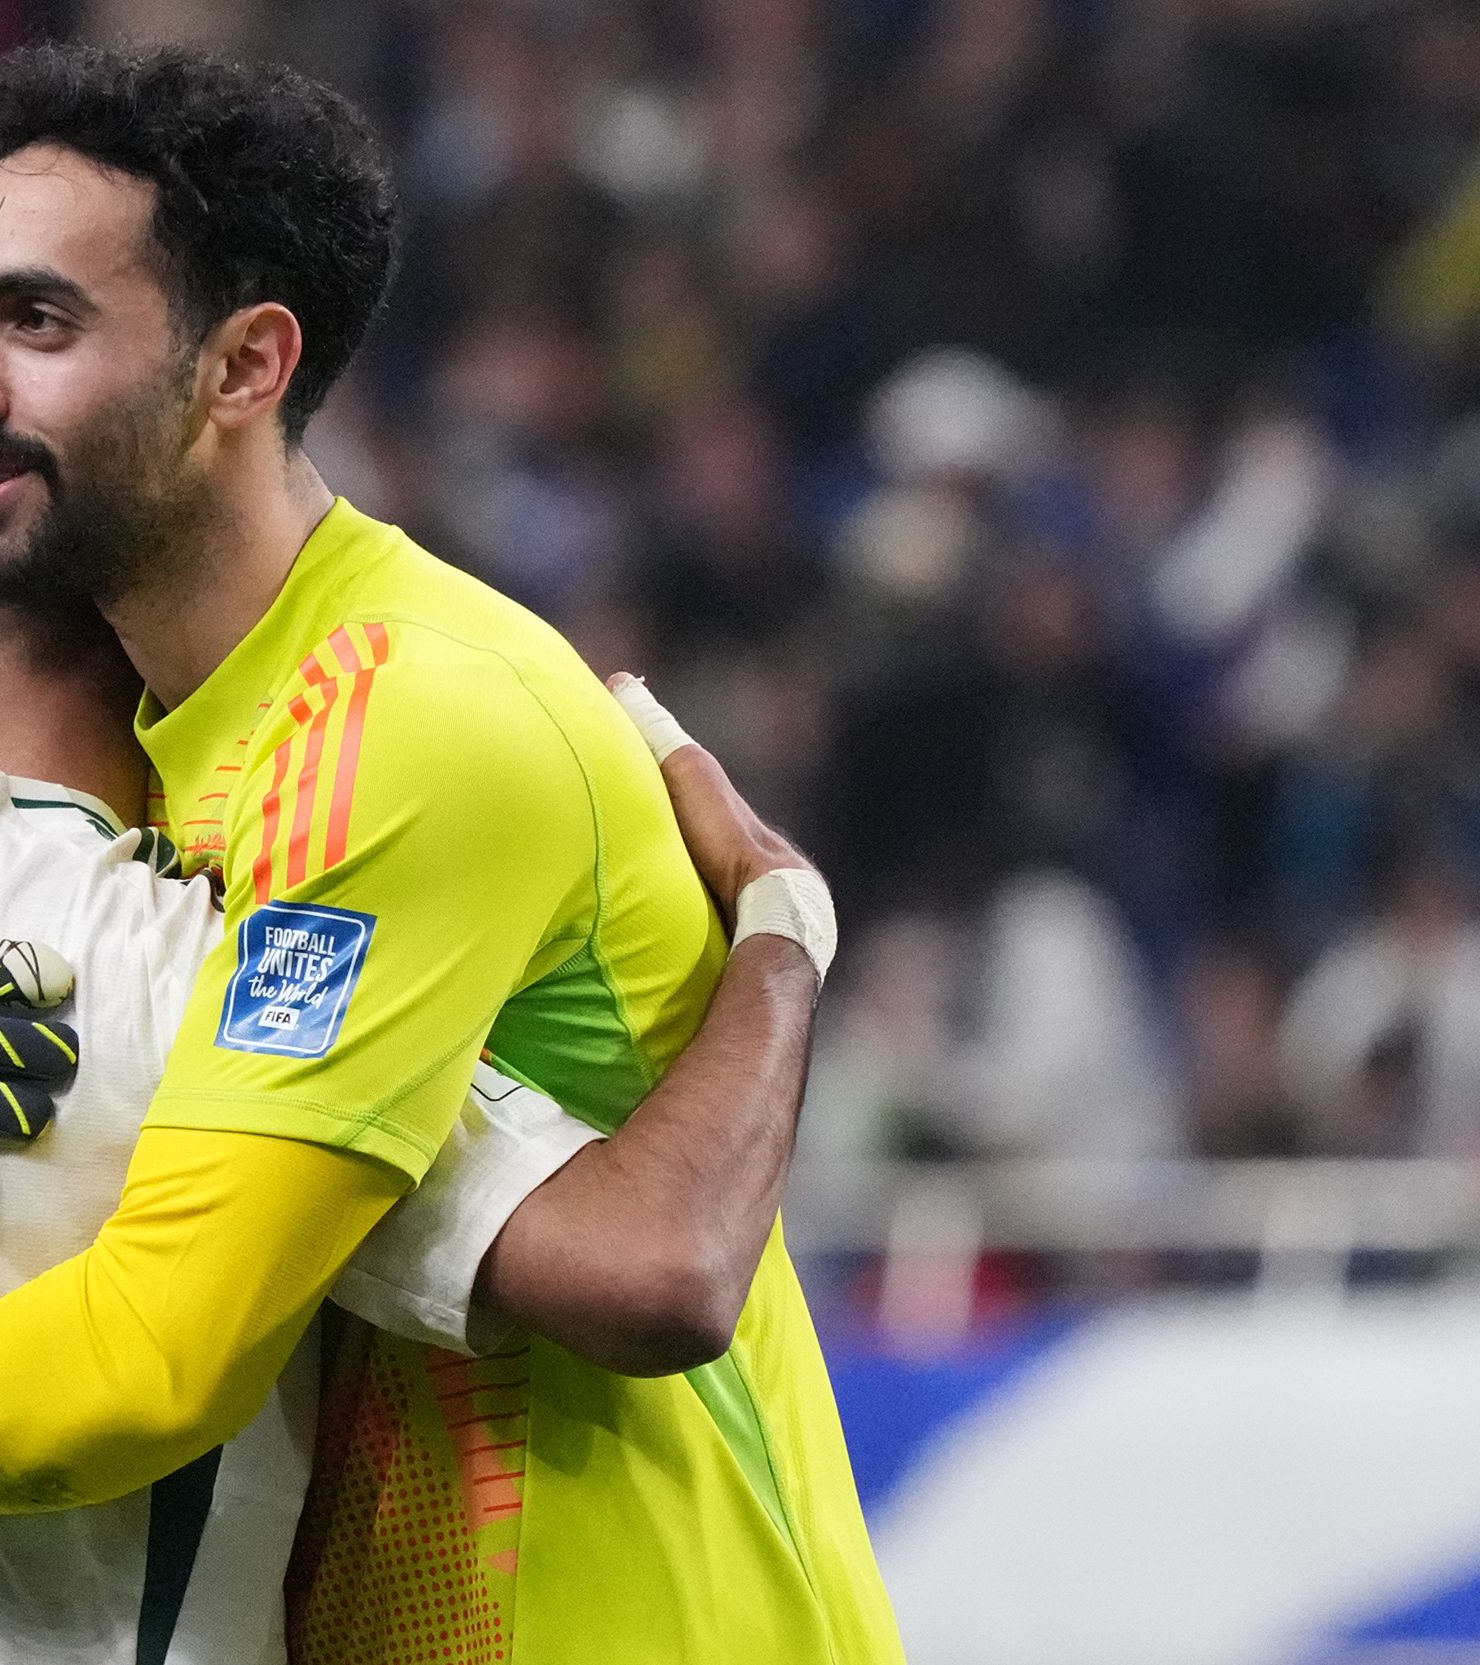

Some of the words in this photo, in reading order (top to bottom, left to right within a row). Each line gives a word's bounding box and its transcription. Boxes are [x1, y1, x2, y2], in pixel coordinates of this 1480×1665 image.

[265, 927, 336, 956] FOOTBALL
[257, 947, 333, 982] UNITES
[248, 975, 277, 998] the
[278, 980, 329, 1009] World
[265, 1011, 291, 1024] FIFA
